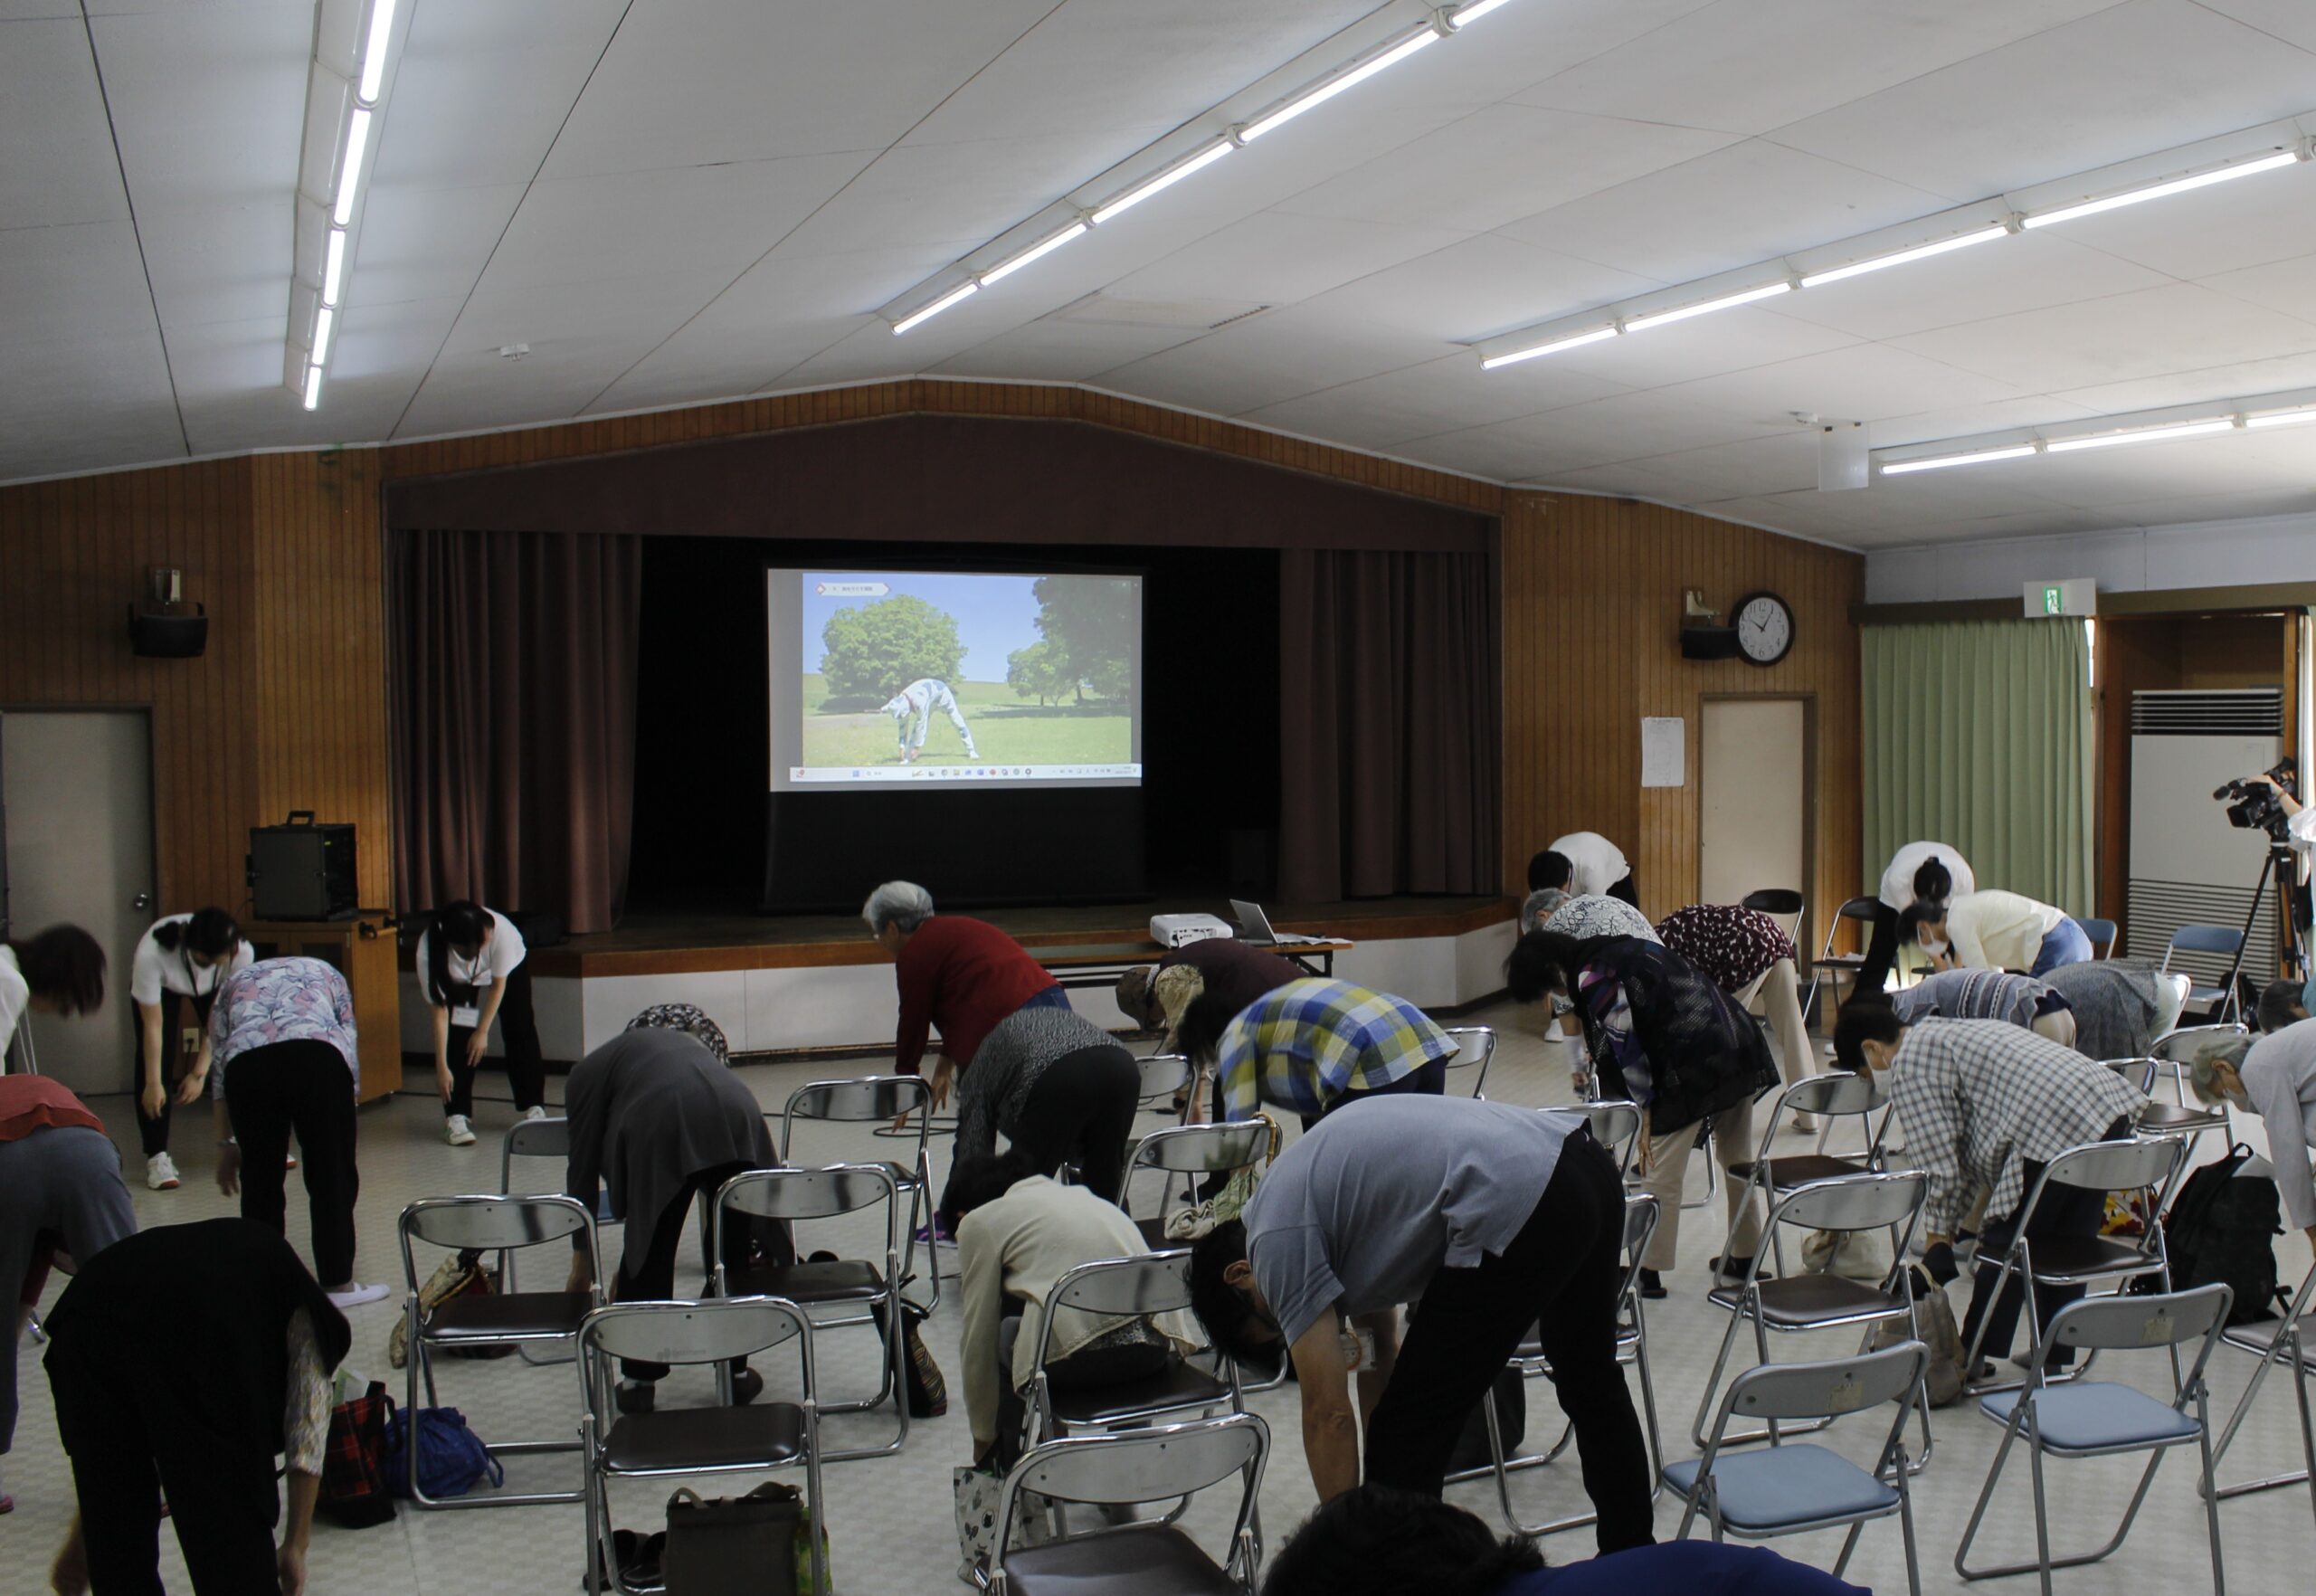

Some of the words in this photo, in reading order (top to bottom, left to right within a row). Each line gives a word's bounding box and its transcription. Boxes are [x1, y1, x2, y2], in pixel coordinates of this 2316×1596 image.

[1750, 603, 1756, 613] 11
[1759, 601, 1767, 613] 12
[1777, 612, 1782, 623] 2
[1739, 623, 1745, 632] 9
[1742, 635, 1749, 645] 8
[1776, 637, 1780, 647] 4
[1750, 644, 1755, 656] 7
[1759, 646, 1765, 659] 6
[1768, 644, 1774, 654] 5
